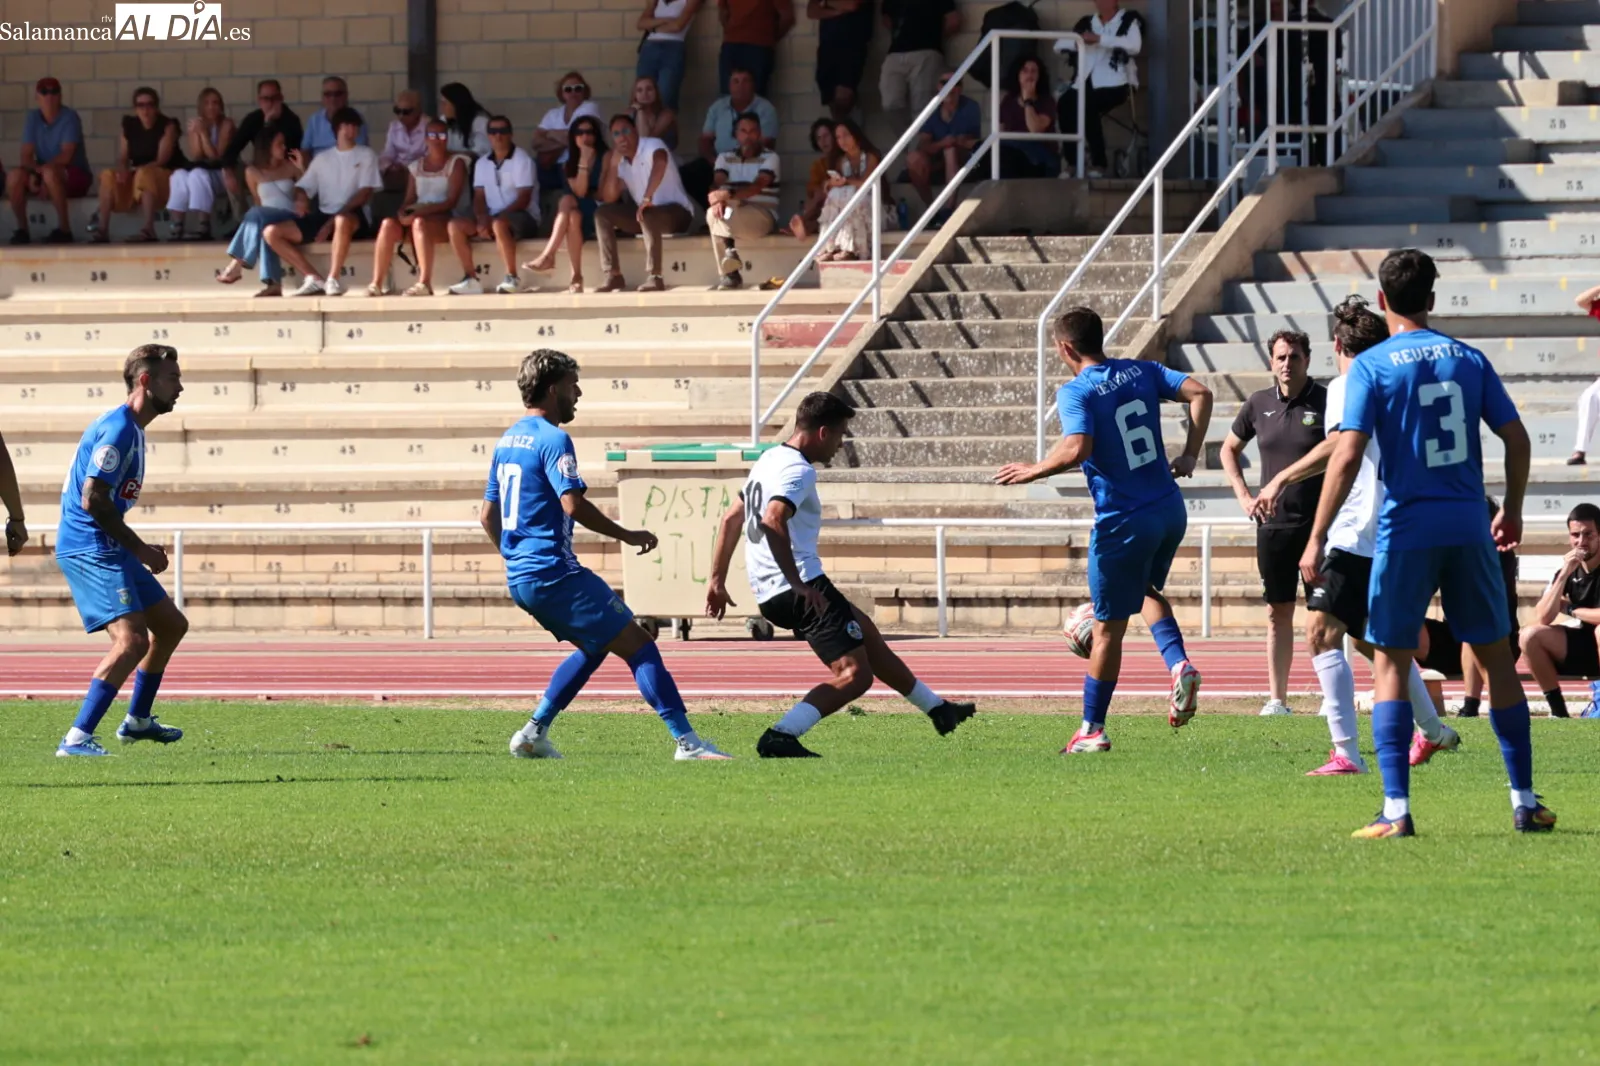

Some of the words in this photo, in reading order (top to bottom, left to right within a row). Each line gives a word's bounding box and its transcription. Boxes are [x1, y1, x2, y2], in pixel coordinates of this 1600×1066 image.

[672, 262, 686, 272] 41
[408, 322, 422, 333] 47
[605, 324, 620, 334] 41
[345, 384, 360, 394] 47
[1418, 380, 1468, 468] 3
[1115, 398, 1158, 471] 6
[1539, 434, 1556, 444] 27
[472, 444, 486, 454] 41
